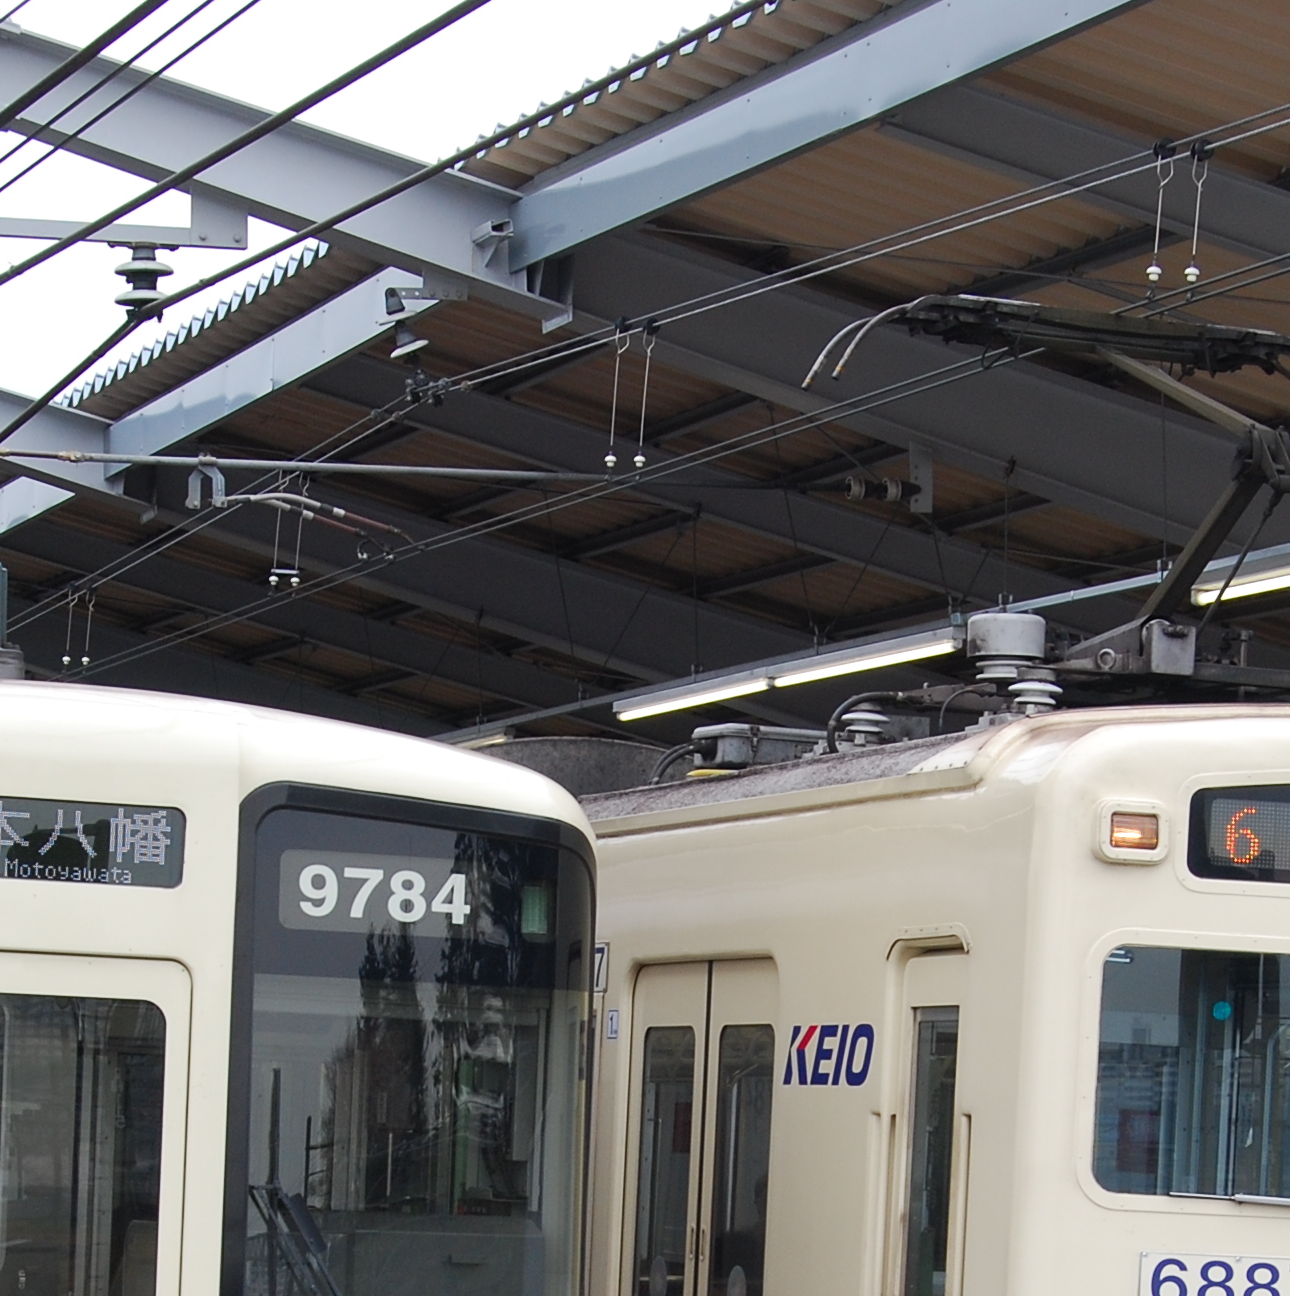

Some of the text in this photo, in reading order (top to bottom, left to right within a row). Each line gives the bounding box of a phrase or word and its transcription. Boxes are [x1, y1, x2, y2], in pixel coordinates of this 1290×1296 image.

[4, 858, 132, 884] Motoyawata
[298, 863, 471, 925] 9784
[782, 1023, 875, 1087] KEIO
